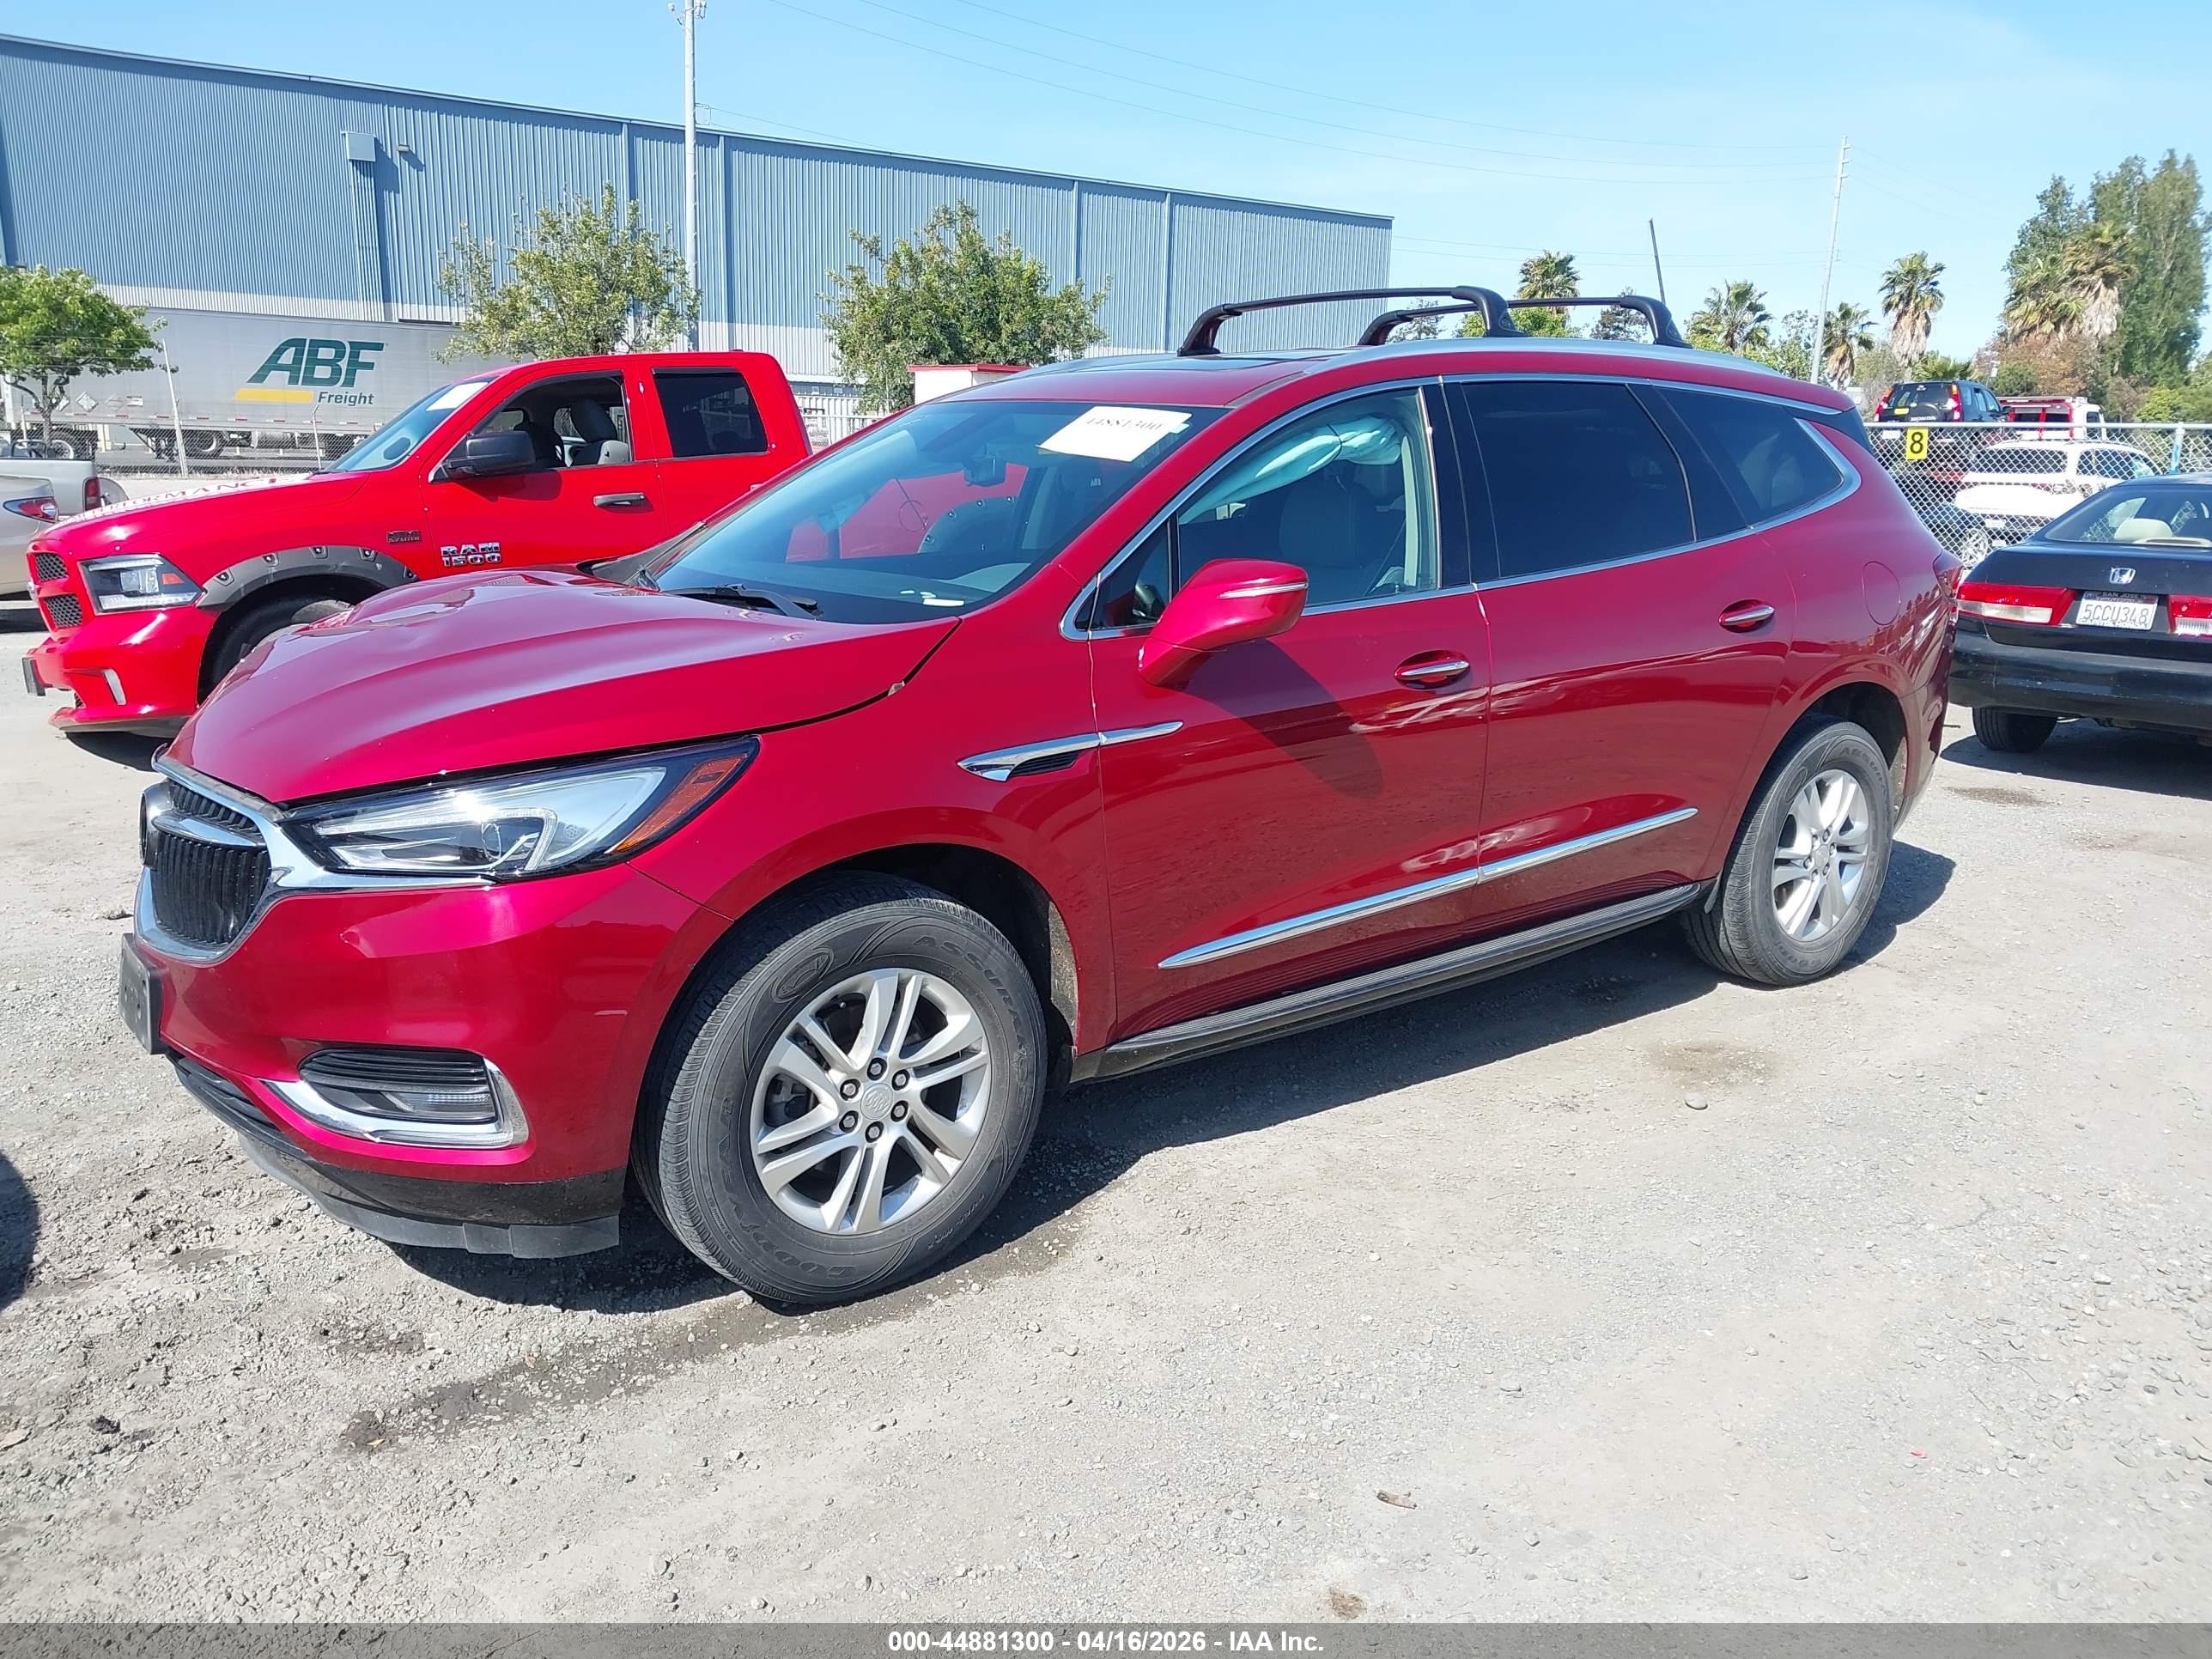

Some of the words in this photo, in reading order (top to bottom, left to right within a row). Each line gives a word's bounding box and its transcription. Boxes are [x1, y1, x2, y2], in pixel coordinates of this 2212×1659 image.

[246, 337, 385, 387] ABF
[318, 391, 375, 407] Freight
[1910, 431, 1924, 454] 8
[440, 542, 501, 556] RAM
[442, 553, 501, 567] 1500
[2082, 604, 2149, 624] 5CCU348
[717, 1096, 857, 1279] GOODYEAR
